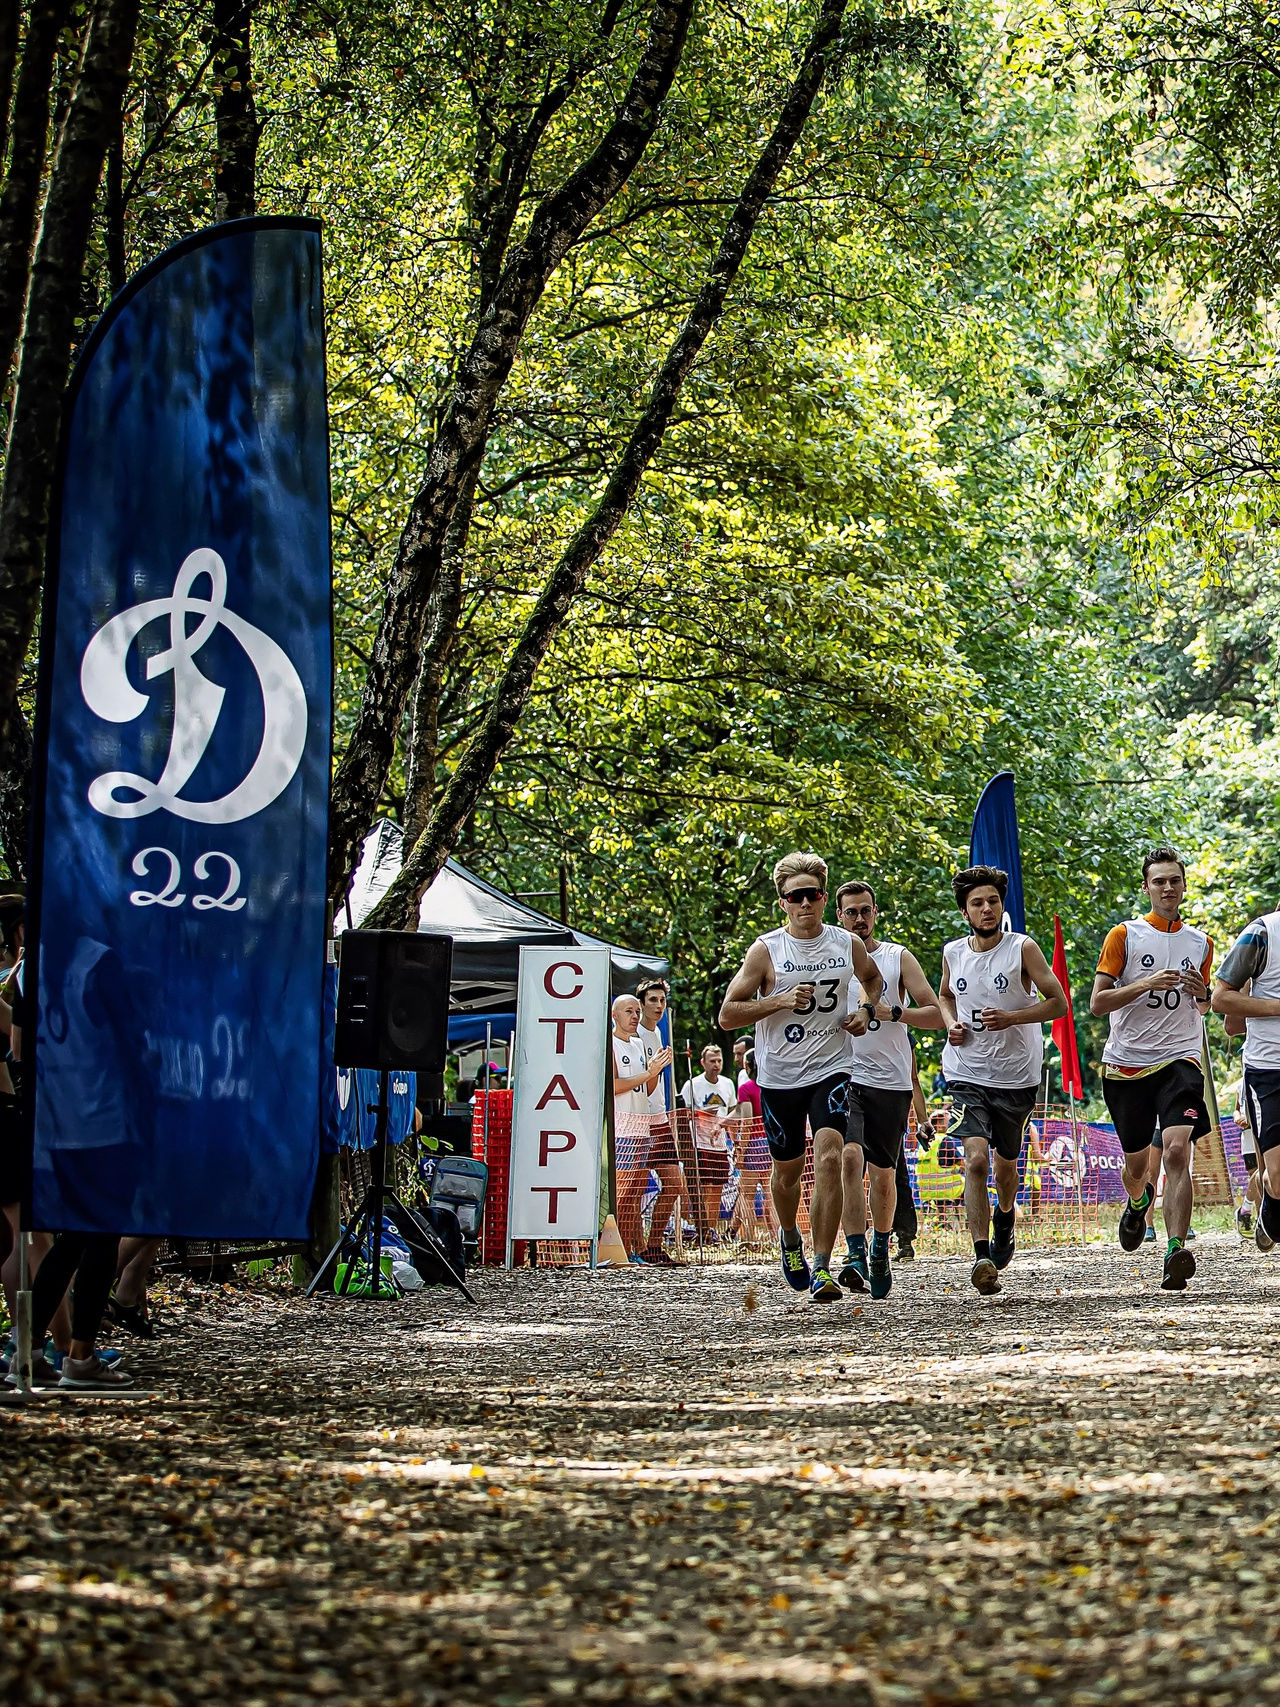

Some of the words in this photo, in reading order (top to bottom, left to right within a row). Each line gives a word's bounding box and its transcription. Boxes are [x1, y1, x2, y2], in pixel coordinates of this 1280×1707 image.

[130, 846, 247, 912] 22
[828, 956, 847, 969] 22
[1146, 988, 1181, 1011] 50
[530, 961, 585, 1225] СТАРТ
[1089, 1155, 1126, 1170] РОСА
